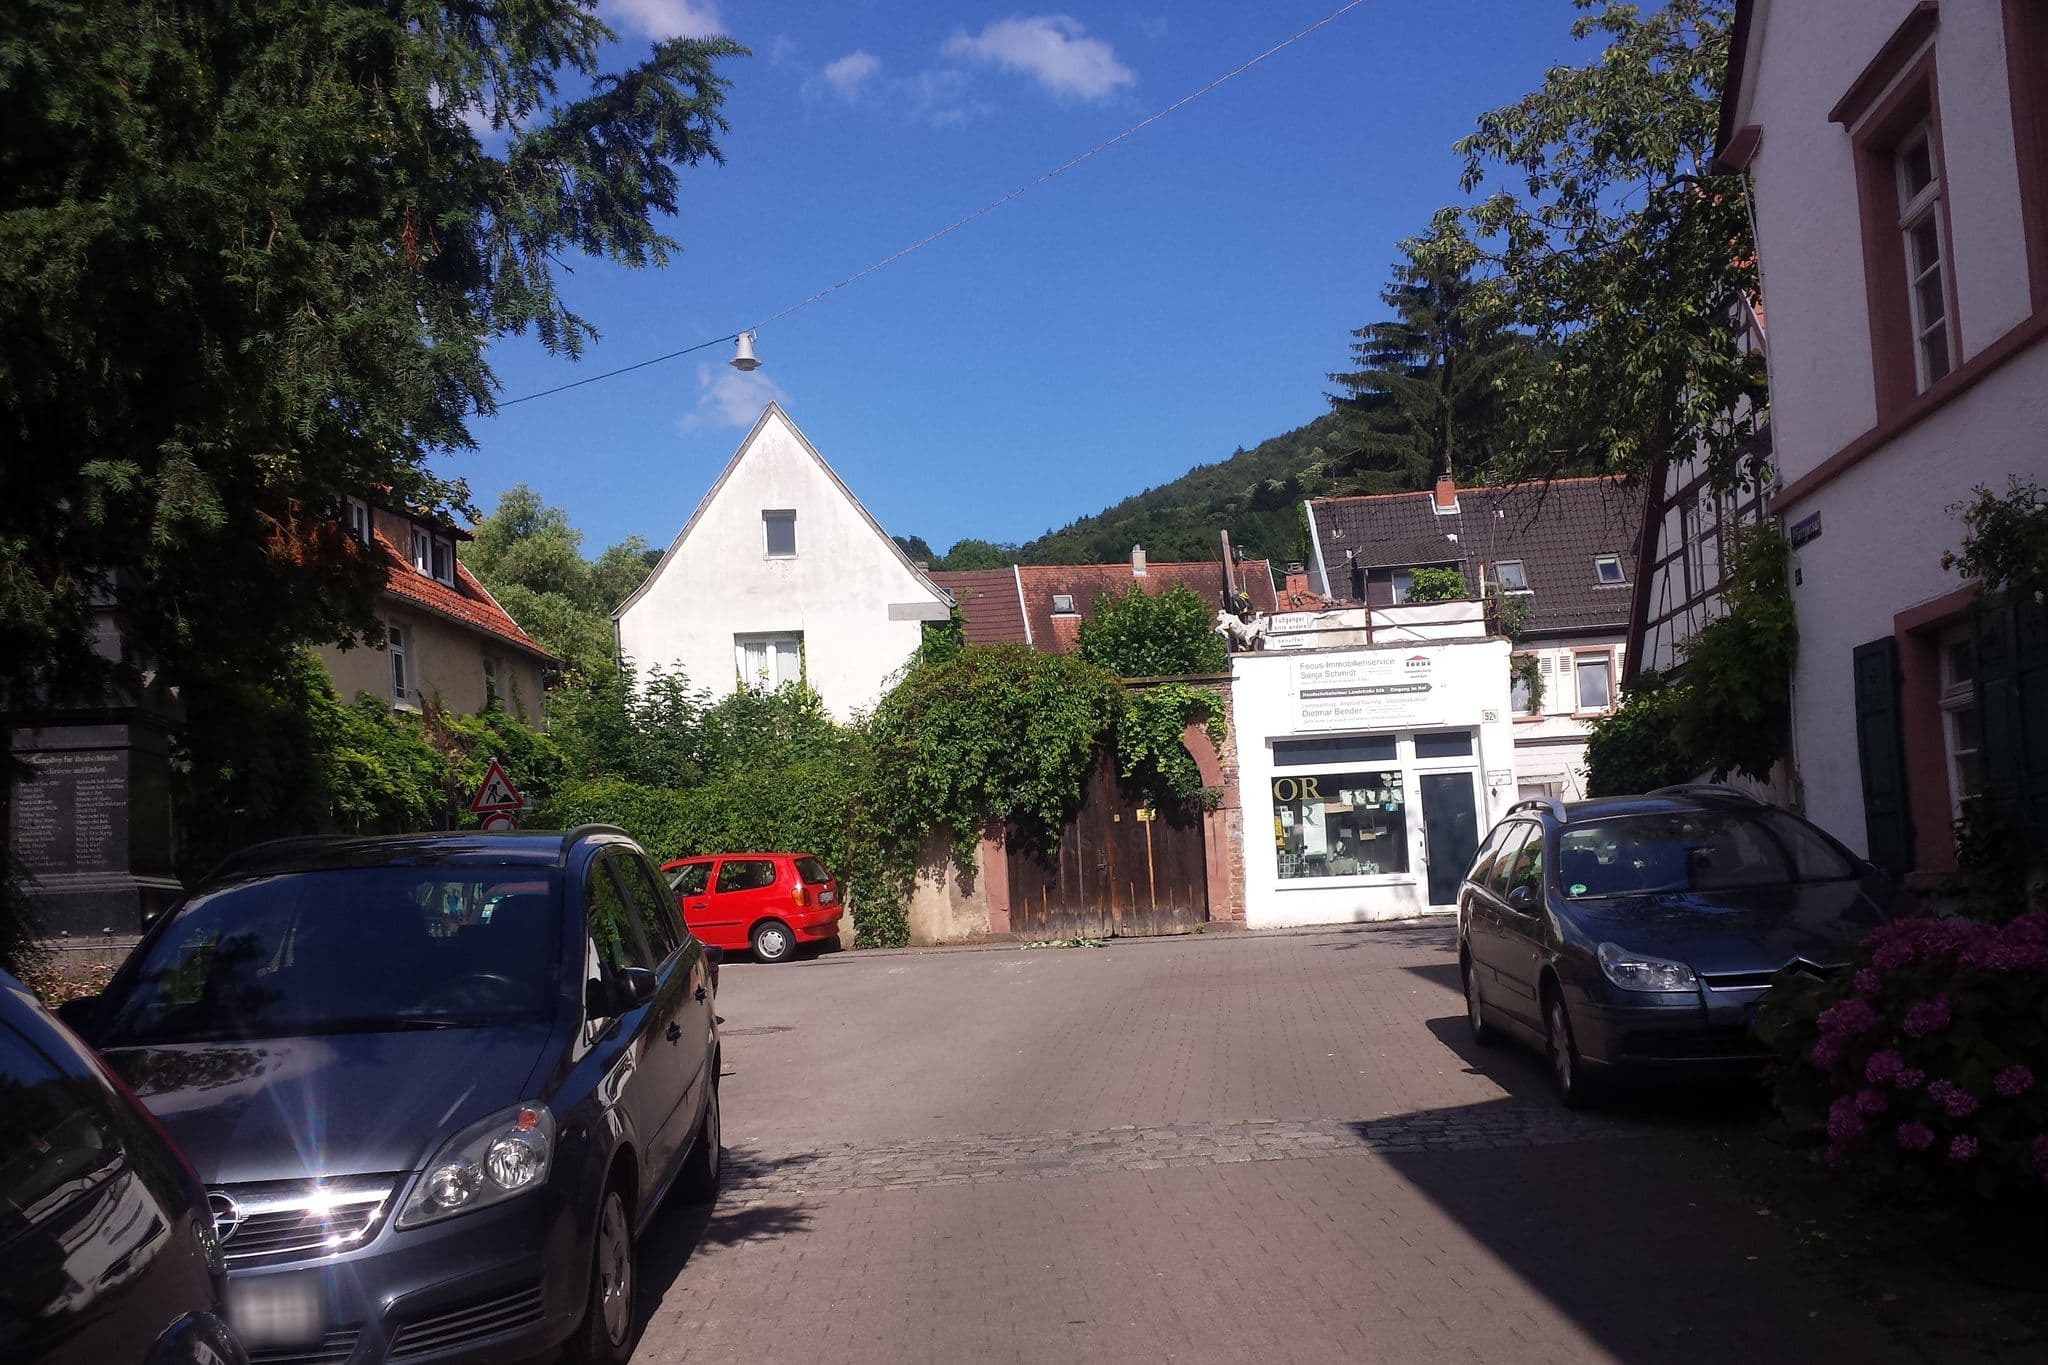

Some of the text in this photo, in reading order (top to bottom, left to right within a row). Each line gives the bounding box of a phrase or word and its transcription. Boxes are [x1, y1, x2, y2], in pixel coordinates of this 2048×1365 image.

[1300, 670, 1323, 680] Sonja
[1324, 669, 1356, 678] Schmidt
[1302, 708, 1333, 717] Dietmar
[1335, 707, 1362, 716] Bender
[1273, 776, 1324, 802] OR
